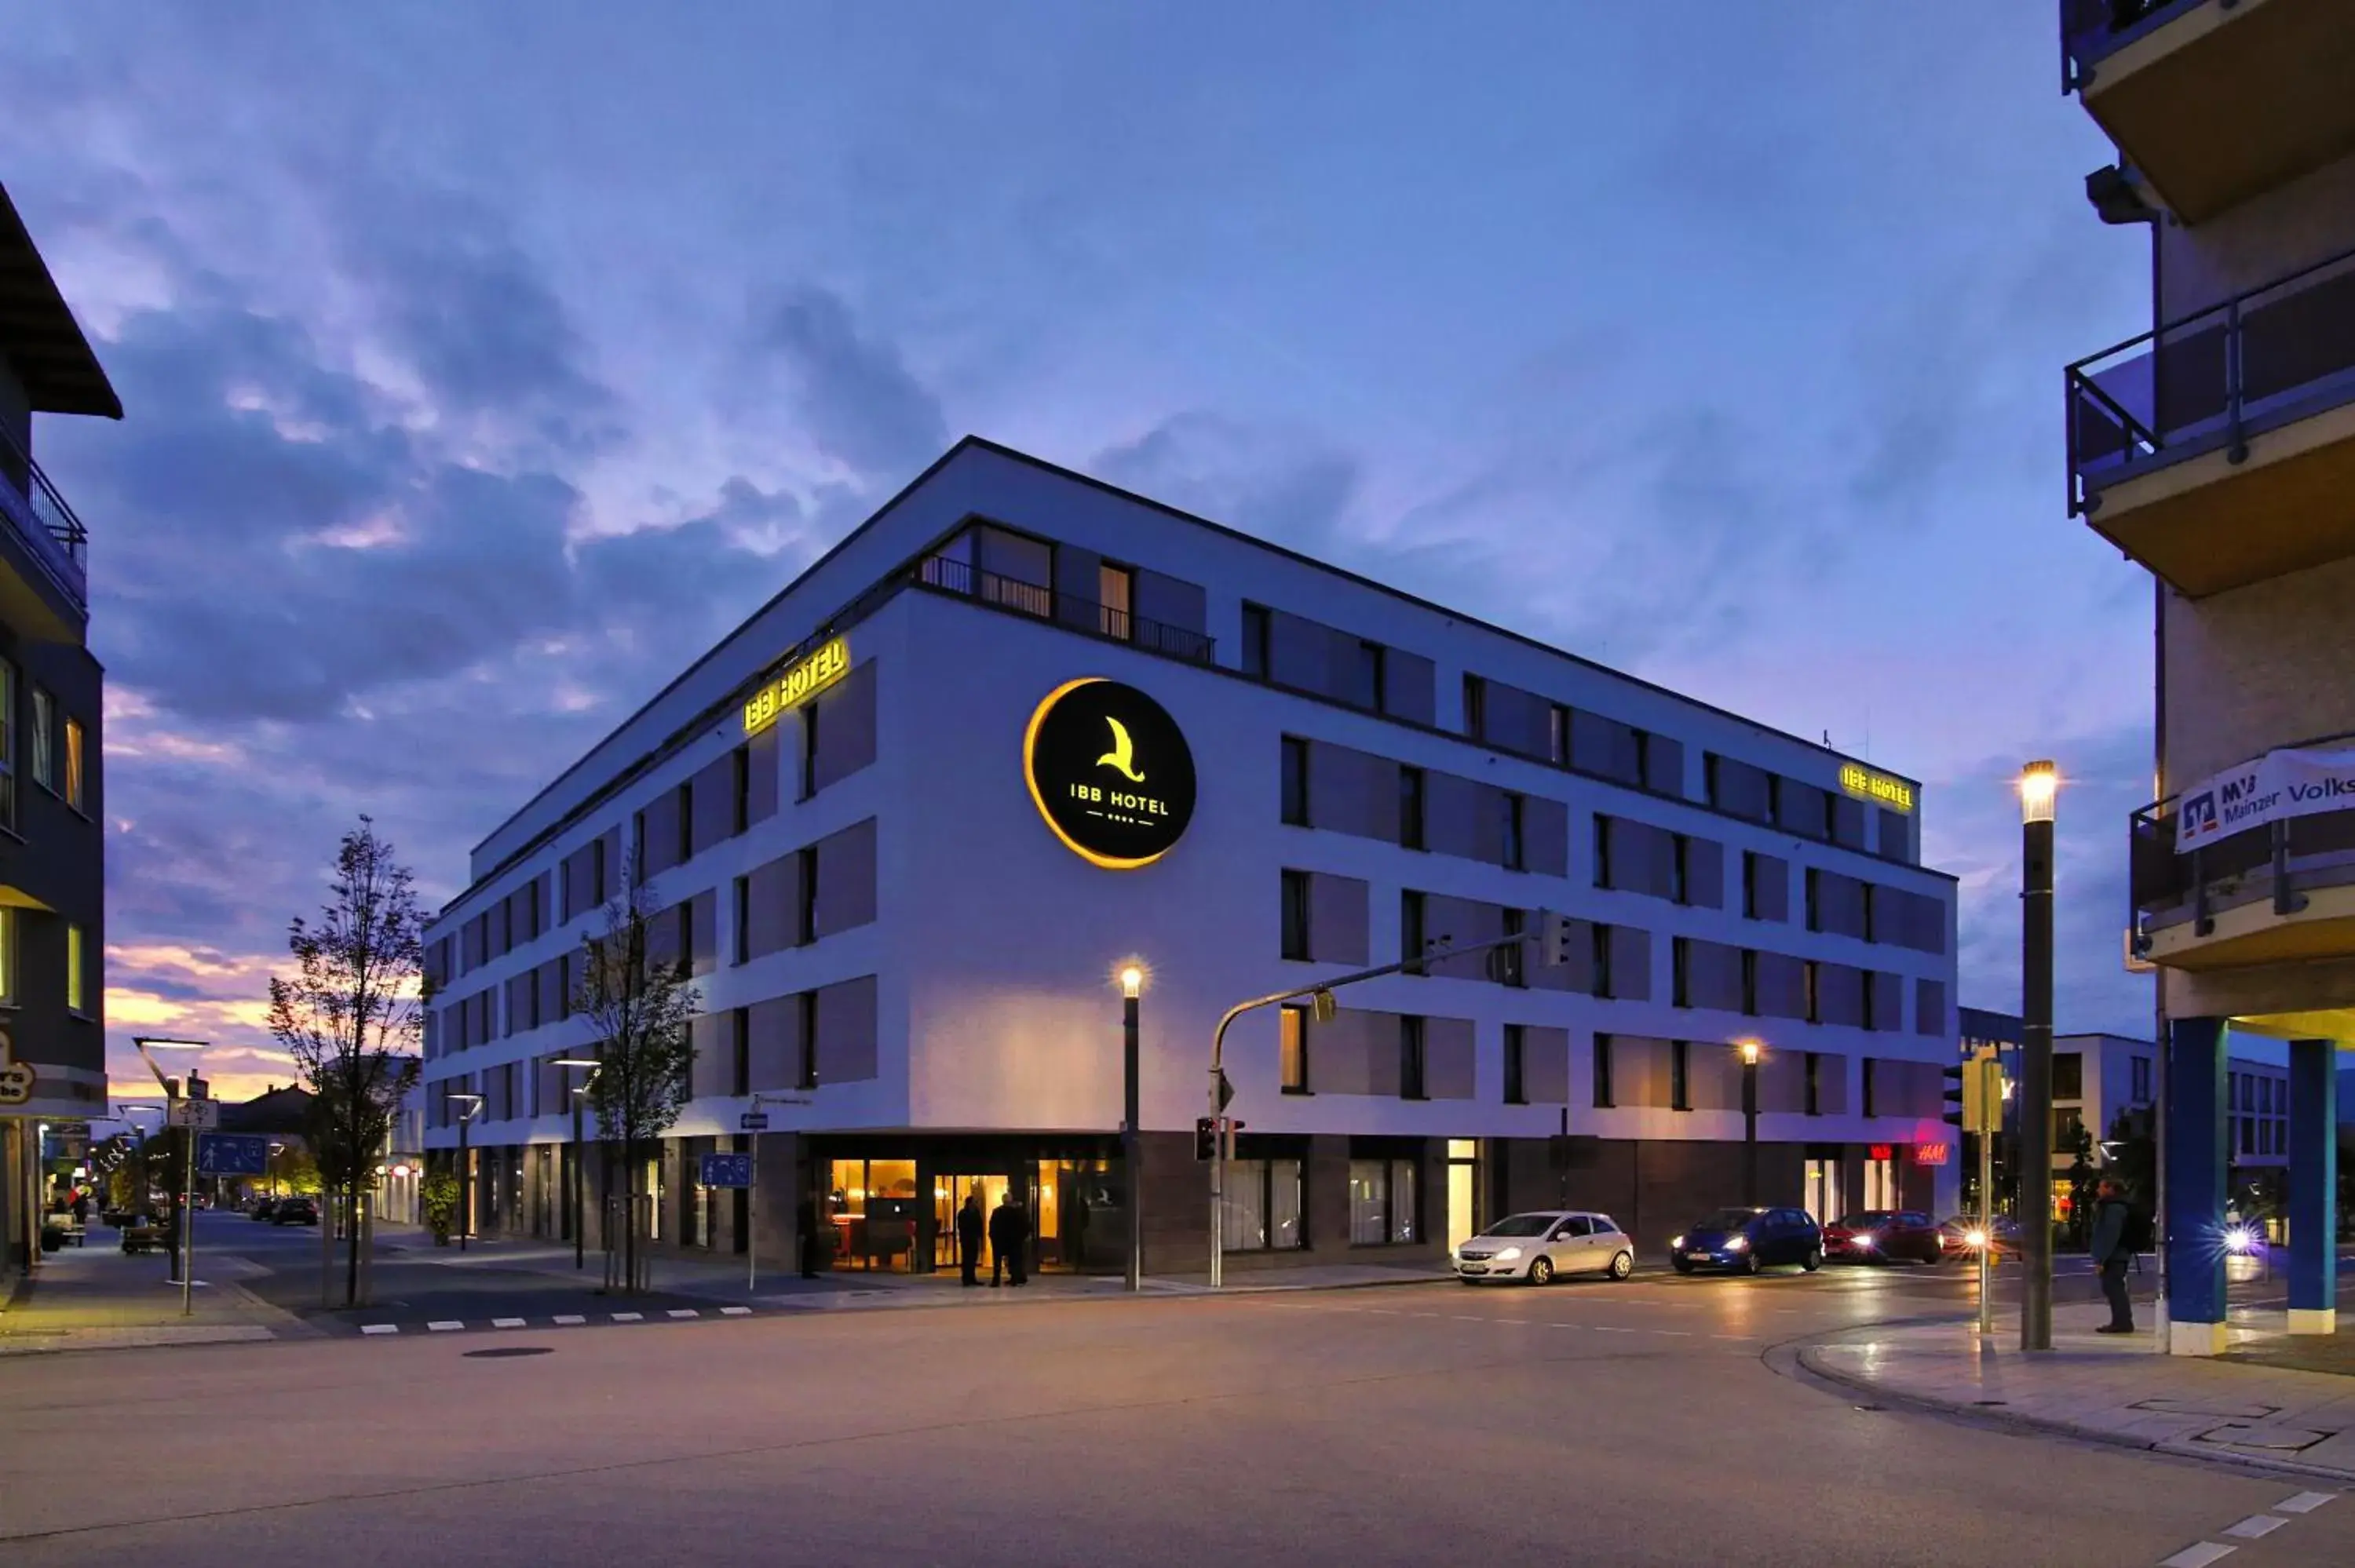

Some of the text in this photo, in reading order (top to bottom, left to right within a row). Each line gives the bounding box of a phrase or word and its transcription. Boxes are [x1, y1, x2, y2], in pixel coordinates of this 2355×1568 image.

[744, 642, 845, 731] IBB HOTEL
[1071, 783, 1169, 816] IBB HOTEL
[1843, 767, 1912, 807] IBB HOTEL
[2225, 777, 2355, 824] Mainzer Volks
